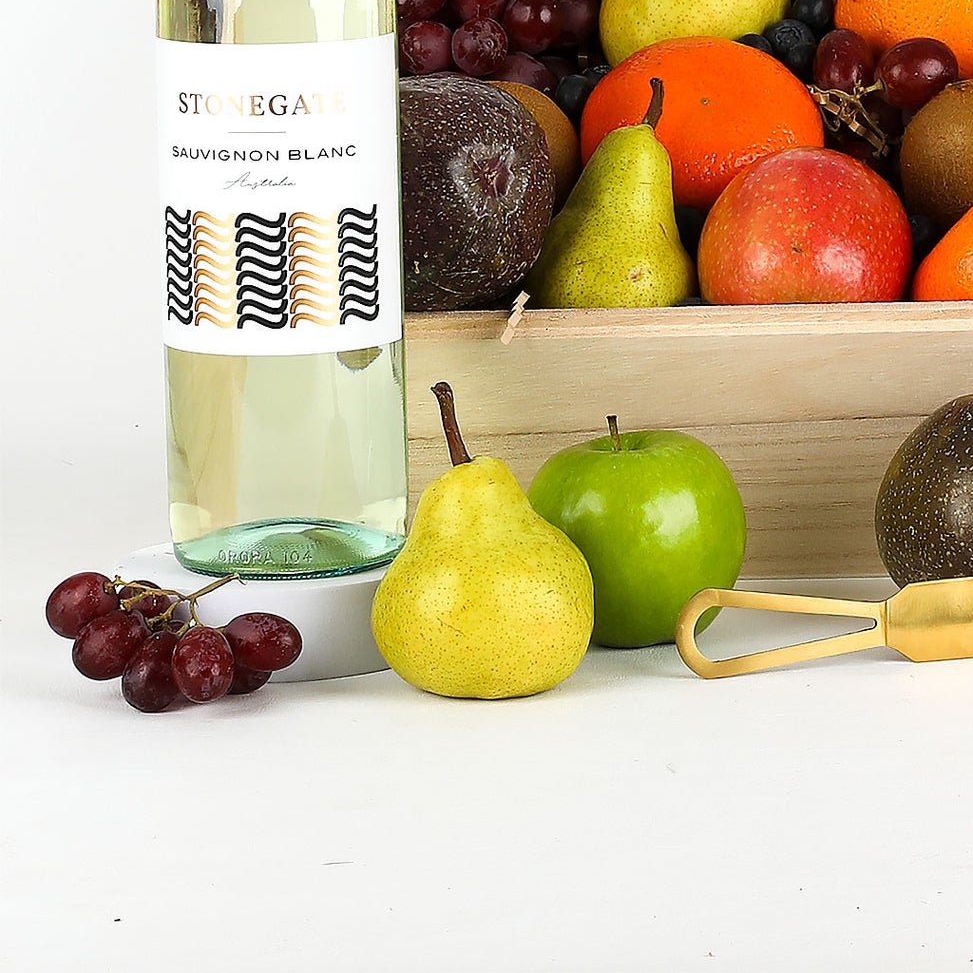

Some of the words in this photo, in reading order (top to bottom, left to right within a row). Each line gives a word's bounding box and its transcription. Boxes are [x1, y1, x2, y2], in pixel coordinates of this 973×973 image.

[178, 91, 347, 117] STONEGATE
[172, 145, 280, 162] SAUVIGNON
[288, 144, 357, 161] BLANC
[223, 171, 297, 190] Australia
